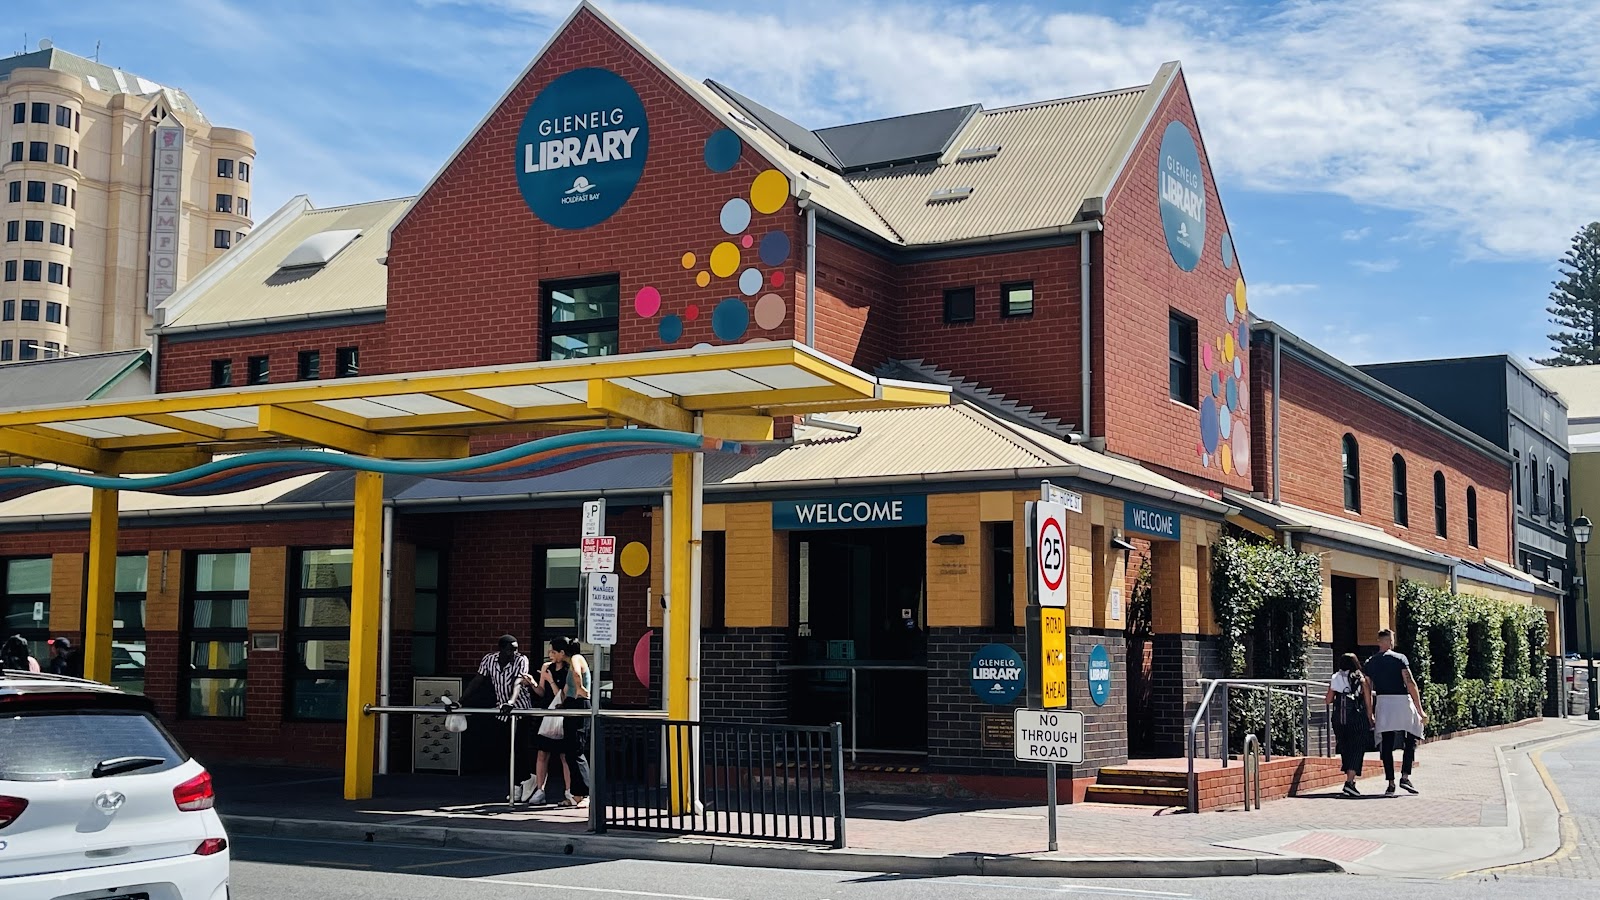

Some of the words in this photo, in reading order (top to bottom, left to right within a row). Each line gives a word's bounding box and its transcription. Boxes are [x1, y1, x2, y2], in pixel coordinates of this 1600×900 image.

[539, 108, 624, 136] GLENELG
[525, 127, 640, 173] LIBRARY
[1166, 154, 1198, 189] GLENELG
[561, 194, 589, 205] HOLDFAST
[589, 192, 601, 201] BAY
[1161, 170, 1203, 223] LIBRARY
[156, 154, 175, 303] STAMFOR
[795, 500, 903, 523] WELCOME
[1132, 507, 1173, 535] WELCOME
[584, 538, 596, 546] BUS
[600, 538, 613, 547] TAXI
[1044, 537, 1061, 570] 25
[592, 585, 615, 593] MANAGED
[592, 593, 602, 601] TAXI
[1045, 616, 1062, 634] ROAD
[978, 659, 1015, 667] GLENELG
[972, 667, 1021, 680] LIBRARY
[1045, 681, 1066, 699] AHEAD
[1039, 714, 1058, 727] NO
[1021, 728, 1078, 744] THROUGH
[1030, 745, 1068, 758] ROAD
